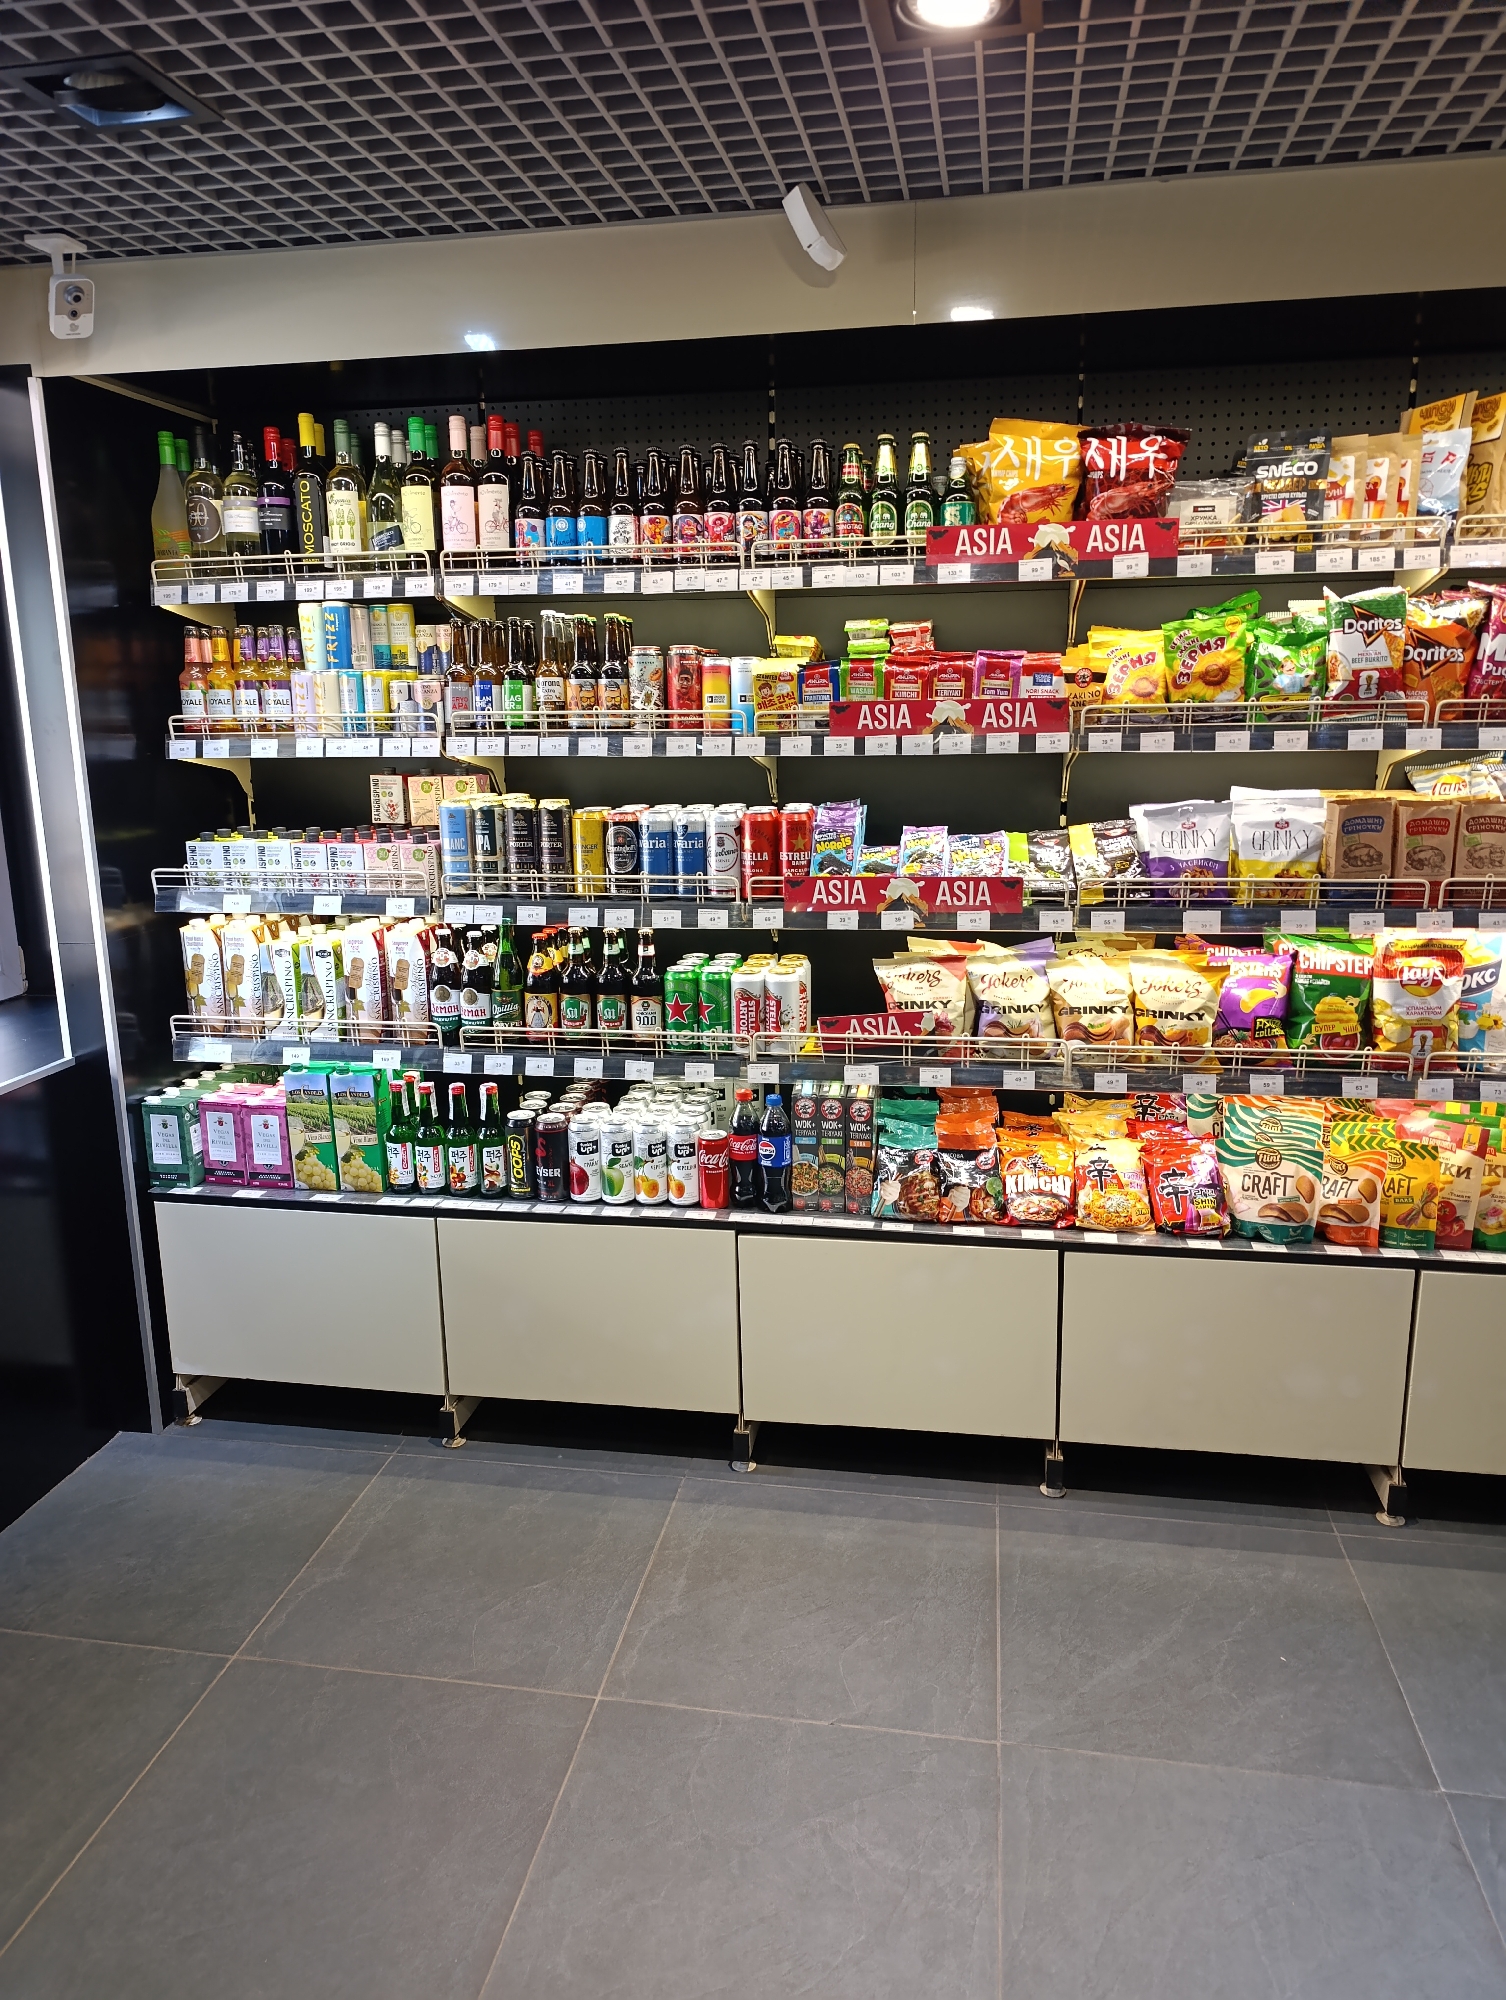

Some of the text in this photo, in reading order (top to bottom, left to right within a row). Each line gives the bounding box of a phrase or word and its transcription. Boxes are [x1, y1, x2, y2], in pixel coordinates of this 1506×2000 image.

[1256, 462, 1318, 478] SNECO
[300, 480, 314, 555] MOSCATO
[870, 520, 894, 530] Chang
[906, 520, 931, 529] Chang
[955, 528, 1012, 556] ASIA
[1086, 524, 1146, 553] ASIA
[324, 612, 338, 663] FRIZZ
[1343, 618, 1402, 635] Doritos
[1176, 636, 1226, 684] ЗЕРНЯ
[858, 704, 912, 730] ASIA
[982, 702, 1037, 728] ASIA
[1161, 828, 1219, 849] GRINKY
[1252, 828, 1313, 850] GRINKY
[812, 880, 866, 904] ASIA
[936, 881, 991, 906] ASIA
[636, 1016, 656, 1026] 900
[1058, 1006, 1129, 1016] GRINKY
[1135, 1008, 1206, 1022] GRINKY
[850, 1016, 901, 1041] ASIA
[795, 1120, 816, 1128] WOK+
[821, 1121, 842, 1129] WOK+
[850, 1123, 871, 1132] WOK+
[510, 1140, 523, 1178] OOPS
[1005, 1174, 1072, 1198] KIMCHI
[1242, 1172, 1294, 1200] CRAFT
